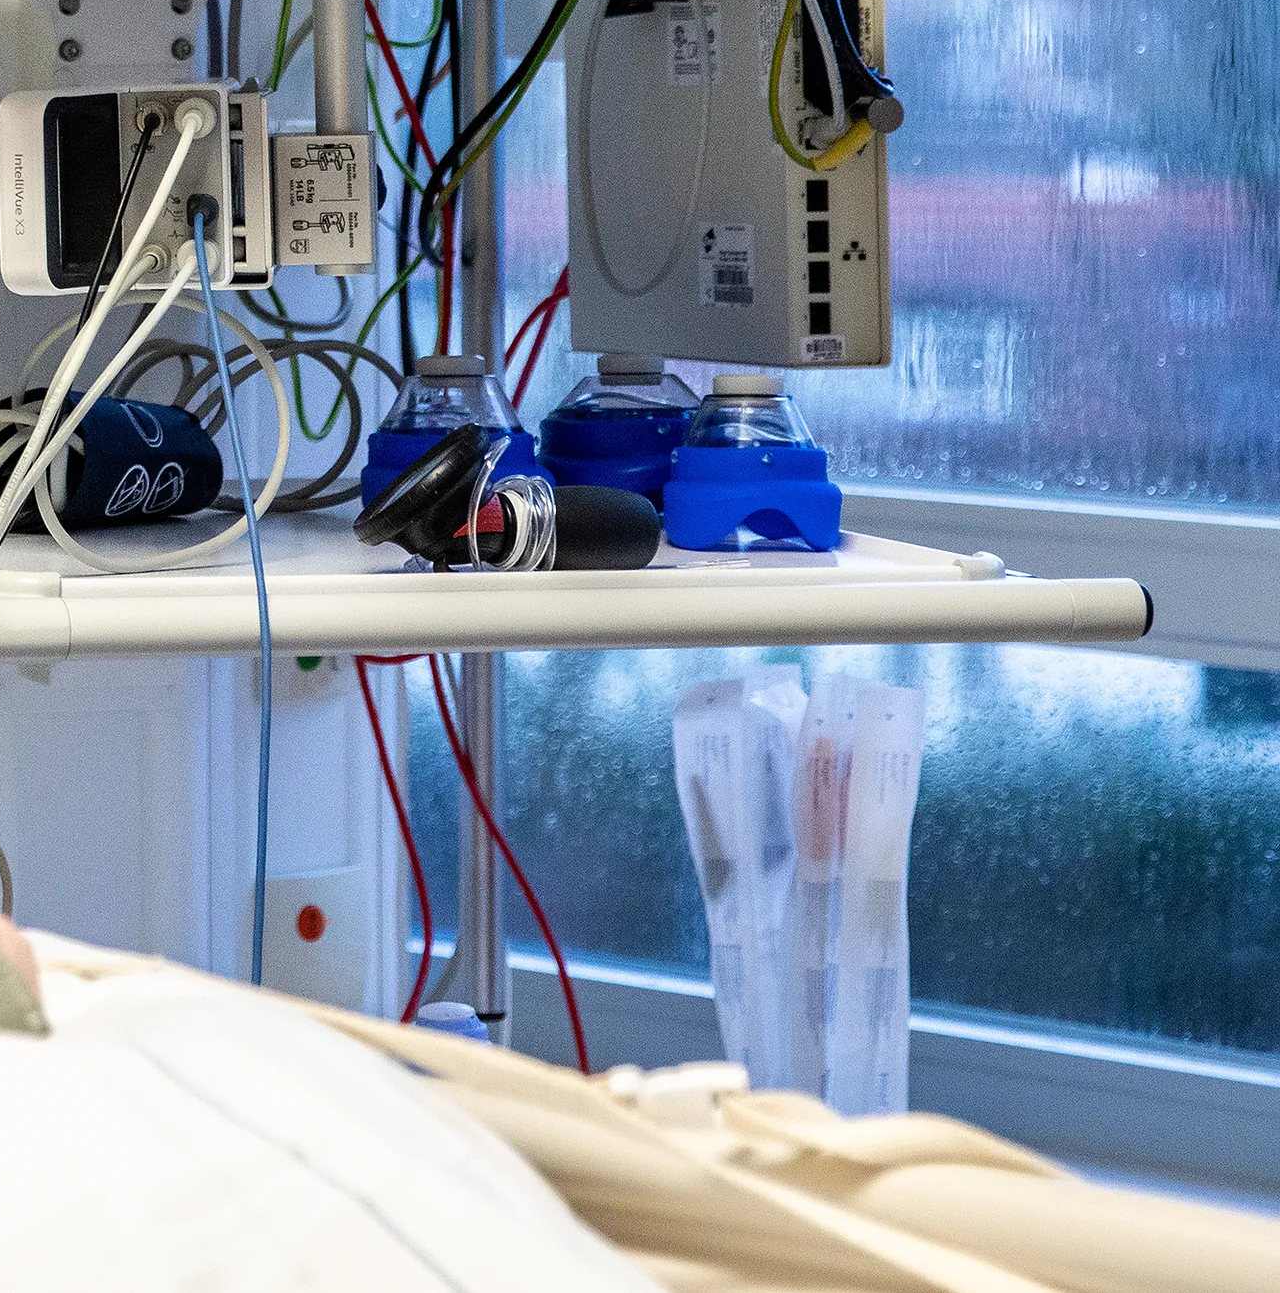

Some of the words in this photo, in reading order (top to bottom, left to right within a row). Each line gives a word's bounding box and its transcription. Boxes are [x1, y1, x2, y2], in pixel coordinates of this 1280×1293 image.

[14, 154, 24, 216] IntelliVue
[295, 179, 304, 190] 14
[306, 179, 315, 194] 6.5
[295, 190, 305, 202] LB
[305, 193, 314, 204] kg
[15, 218, 25, 236] X3
